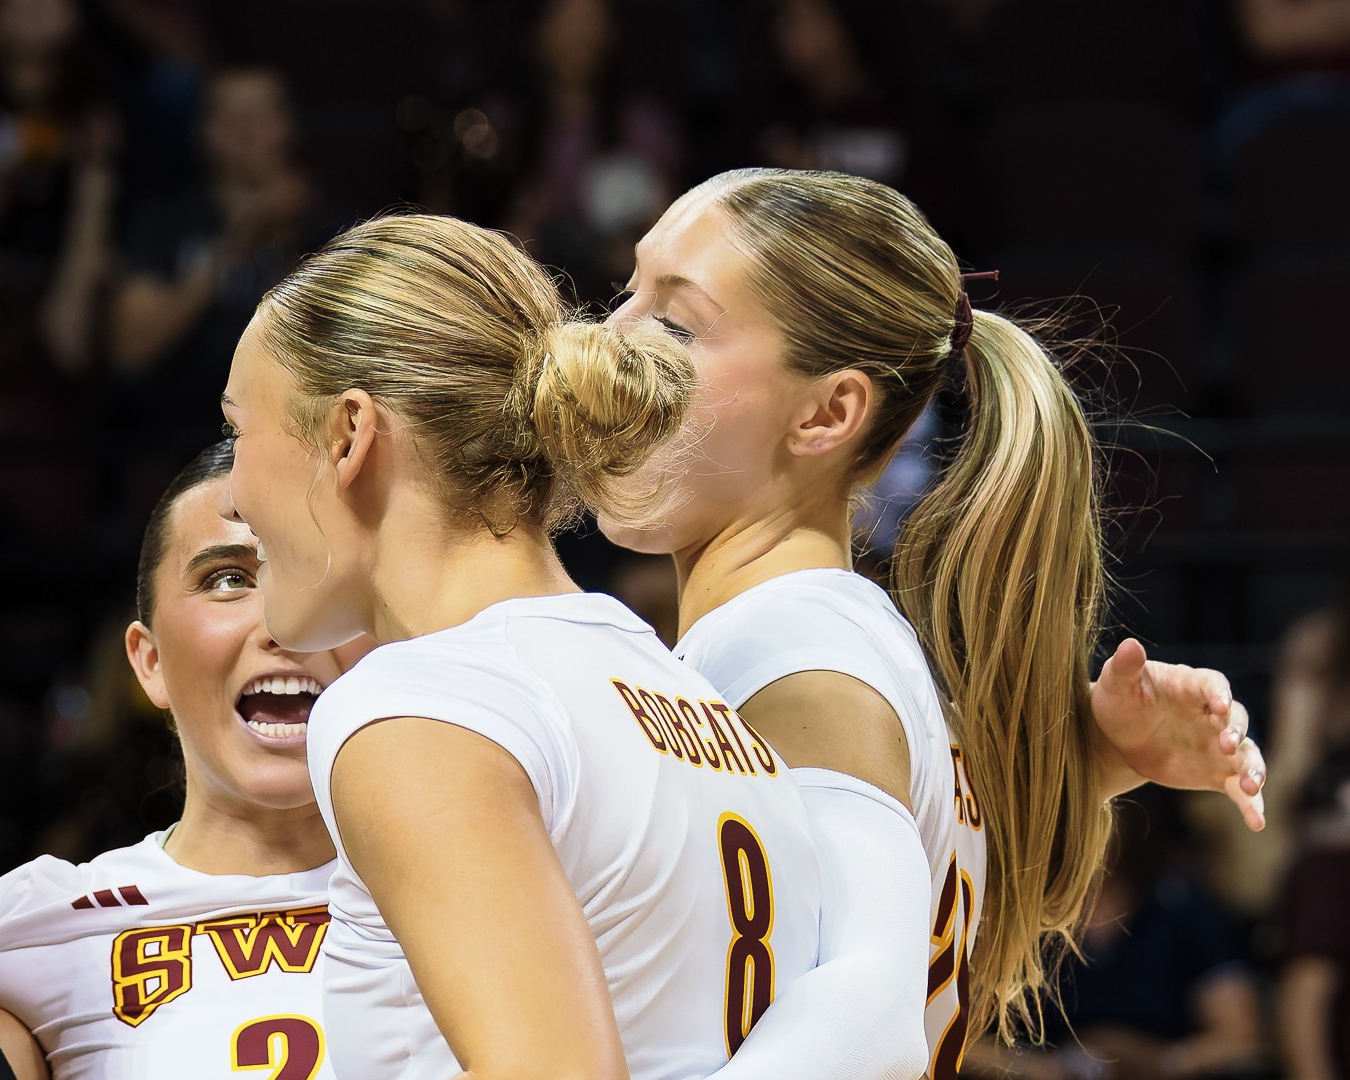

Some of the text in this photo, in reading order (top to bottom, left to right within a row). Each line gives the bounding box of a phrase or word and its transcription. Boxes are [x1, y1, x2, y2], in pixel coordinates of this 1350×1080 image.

[609, 677, 778, 778] BOBCATS
[111, 903, 332, 1028] SW
[716, 811, 776, 1061] 8
